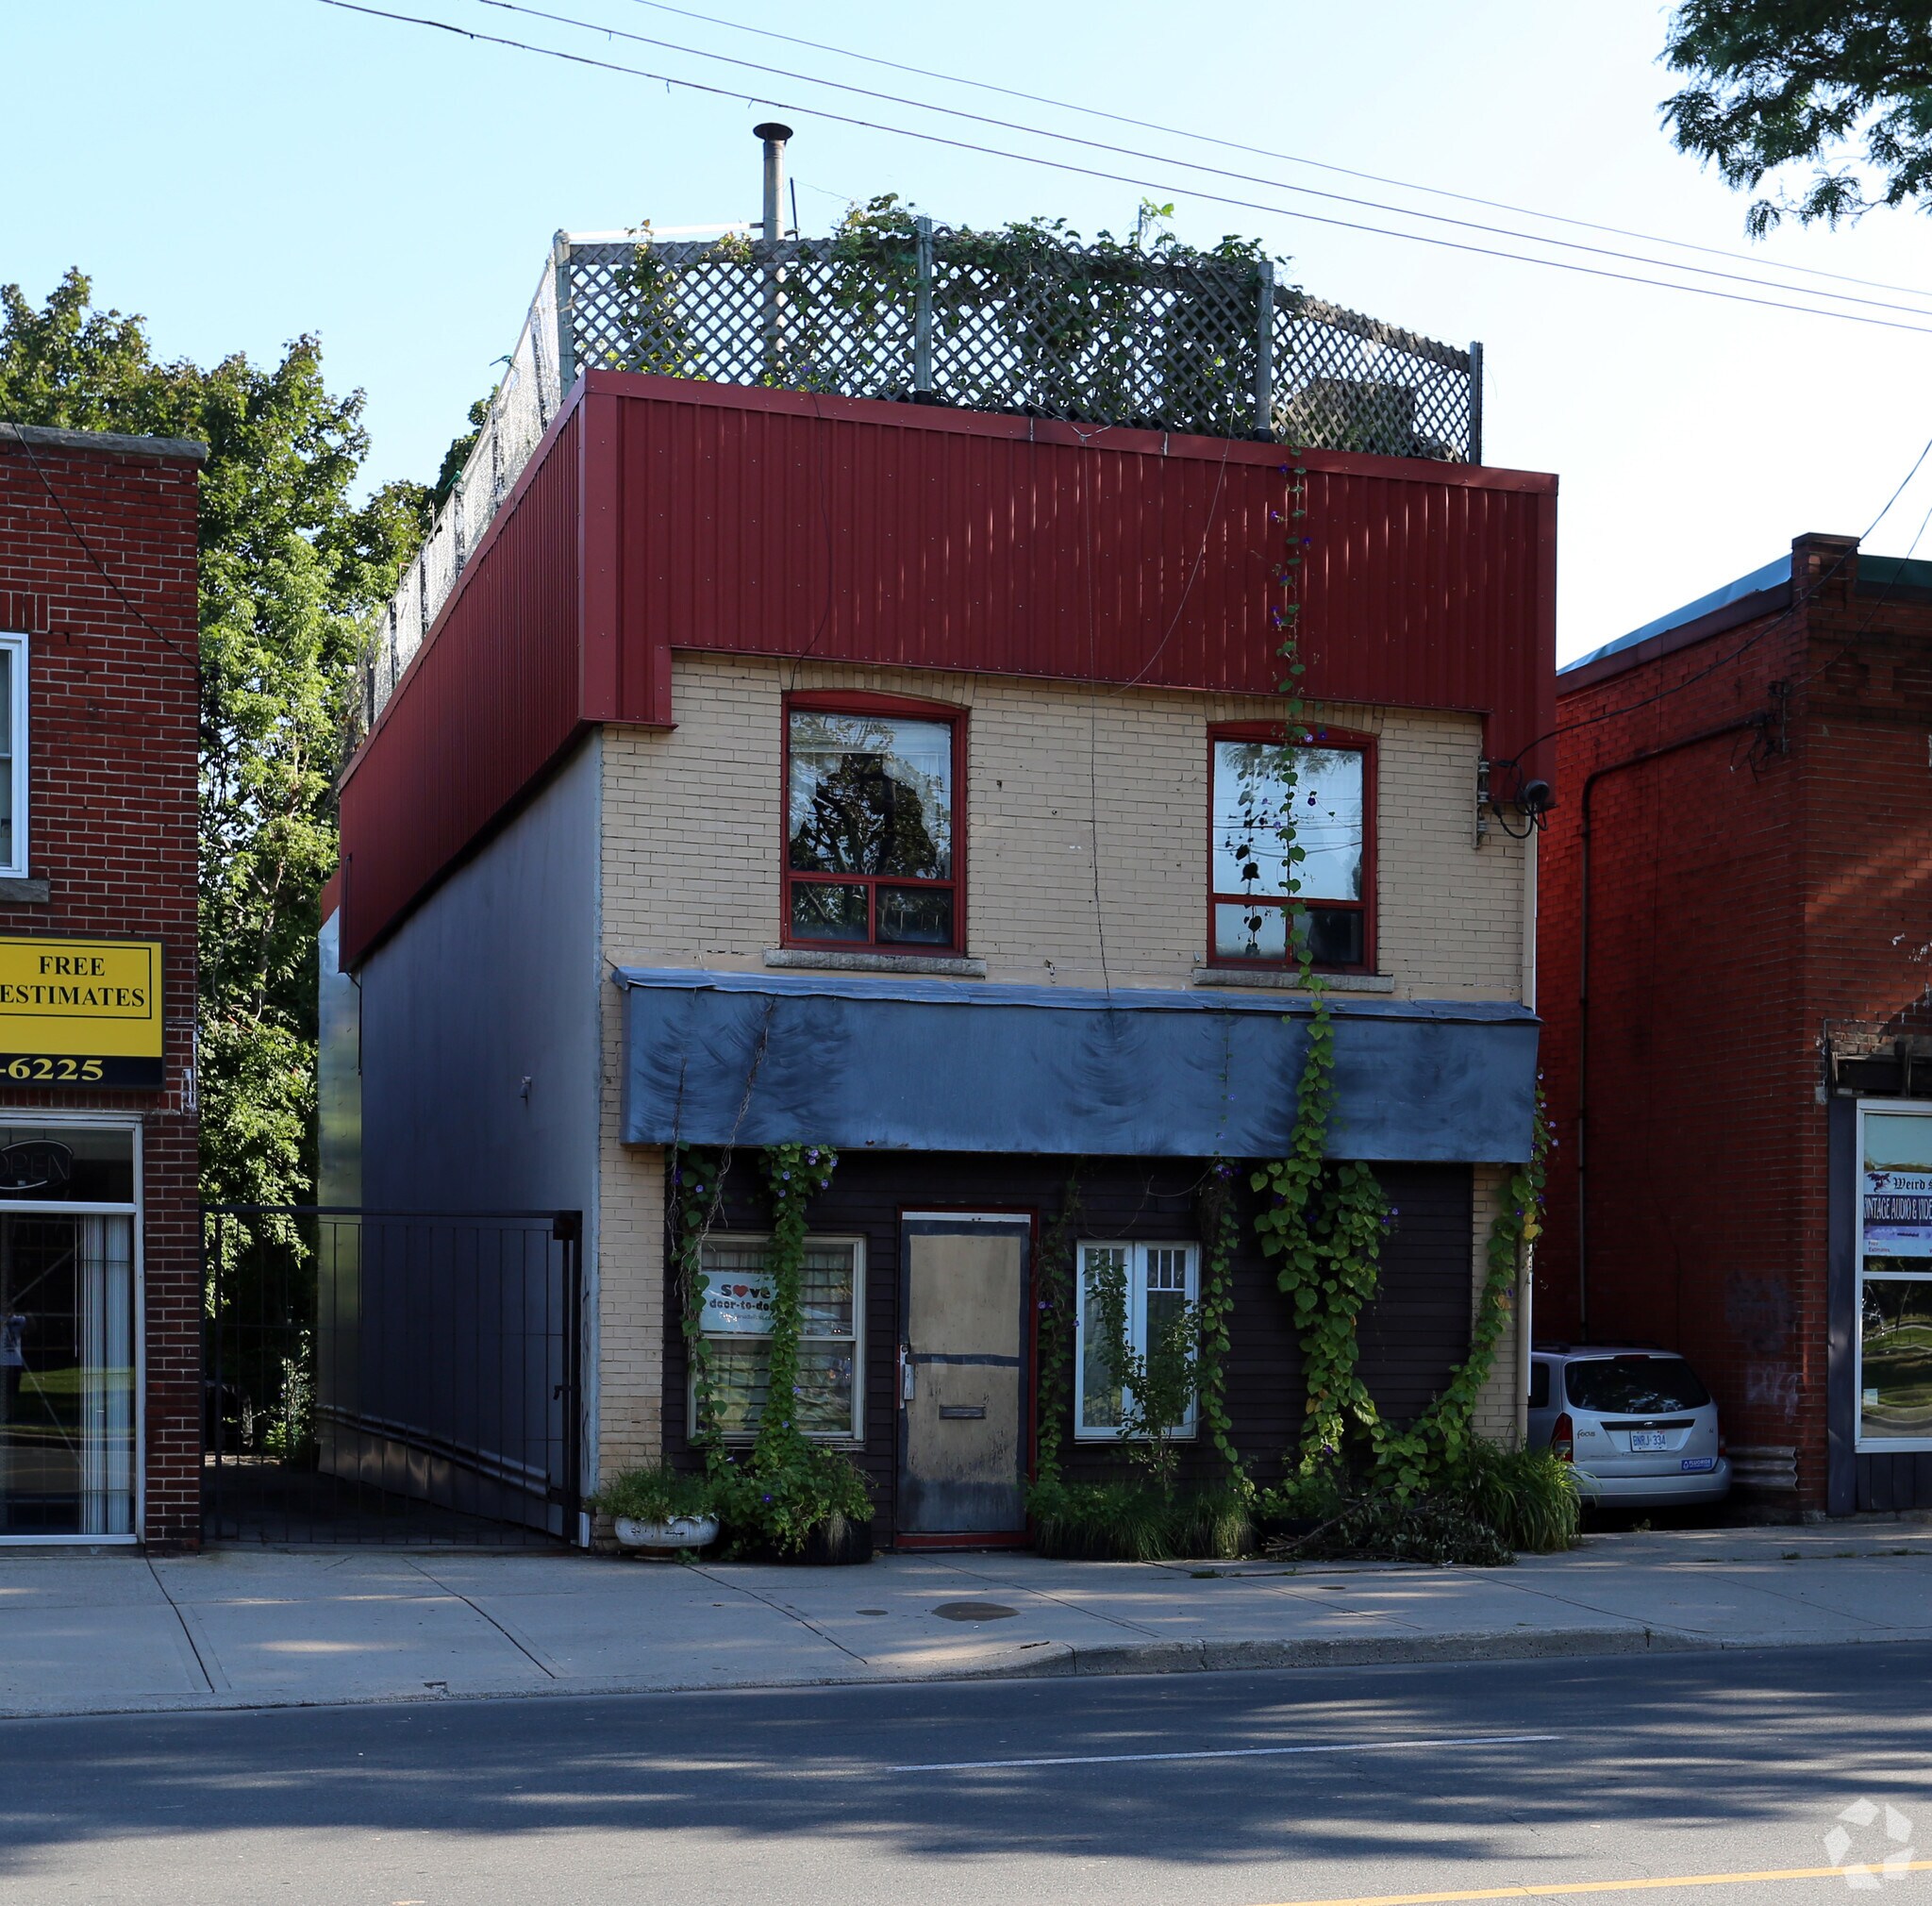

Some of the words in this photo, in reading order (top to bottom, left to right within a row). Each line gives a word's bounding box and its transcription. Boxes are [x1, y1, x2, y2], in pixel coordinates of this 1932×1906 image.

[39, 956, 106, 976] FREE
[0, 984, 145, 1007] ESTIMATES
[0, 1058, 104, 1080] -6225
[1893, 1177, 1926, 1191] Weird
[1890, 1197, 1912, 1221] AUDIO
[1912, 1199, 1918, 1221] &
[709, 1299, 771, 1312] door-to-do
